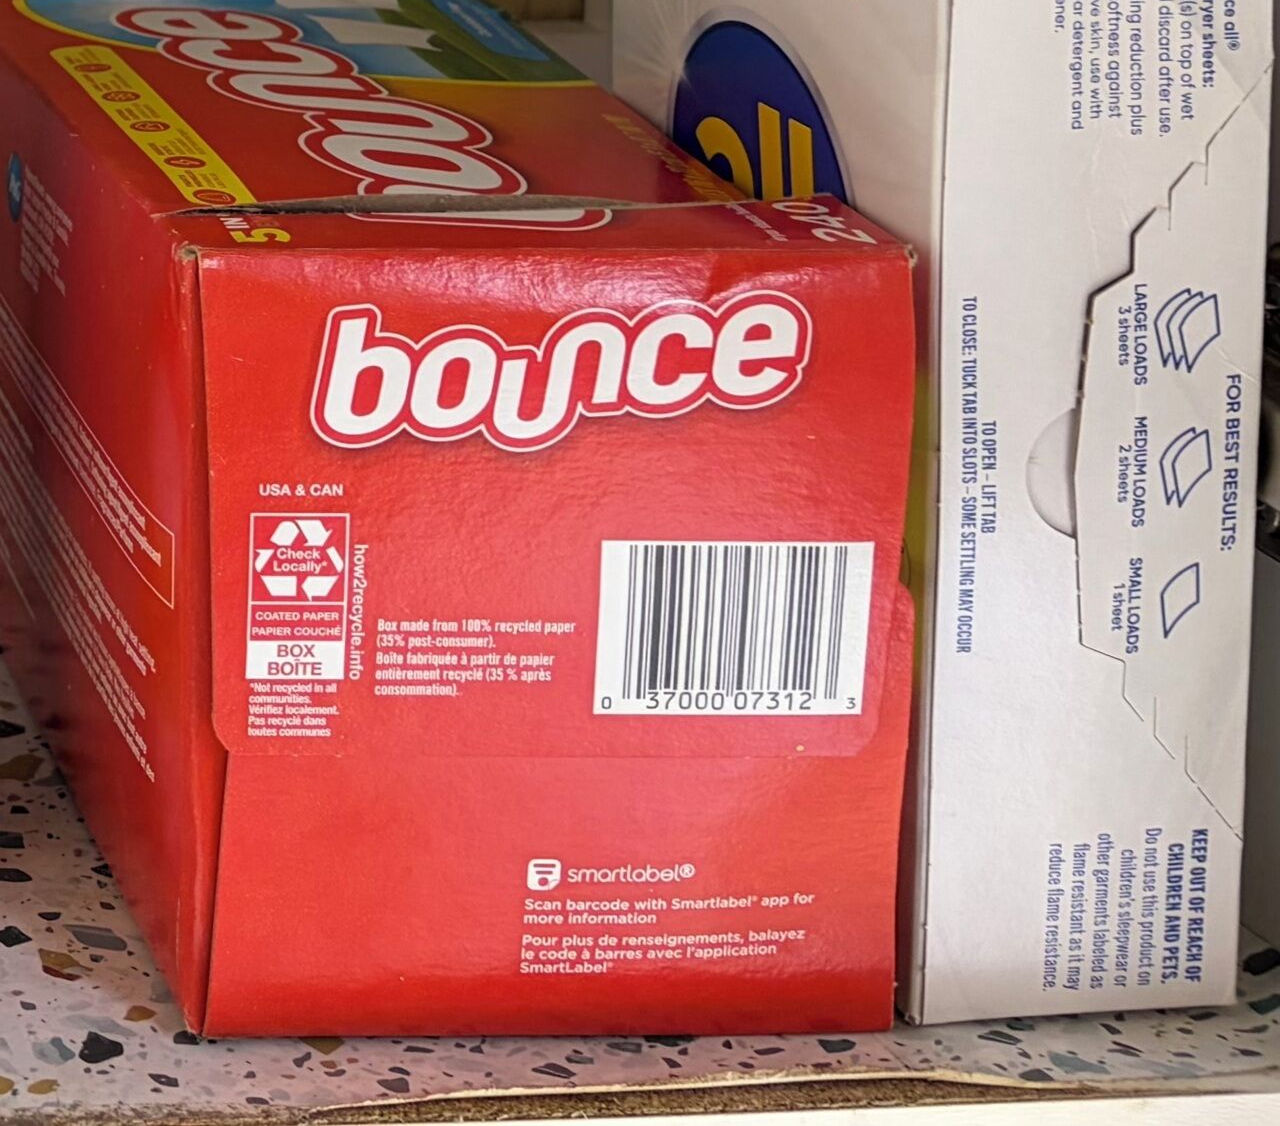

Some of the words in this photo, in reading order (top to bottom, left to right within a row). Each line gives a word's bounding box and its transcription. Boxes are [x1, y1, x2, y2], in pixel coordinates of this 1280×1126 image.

[1181, 21, 1193, 39] on
[1177, 44, 1194, 69] top
[1202, 33, 1216, 88] sheets:
[1181, 73, 1195, 88] of
[1181, 93, 1194, 120] wet
[1119, 306, 1131, 316] 3
[1134, 283, 1147, 332] LARGE
[1118, 318, 1131, 365] sheets
[318, 298, 806, 447] bounce
[1134, 335, 1147, 385] LOADS
[1227, 374, 1241, 412] FOR
[982, 421, 996, 435] TO
[1224, 418, 1240, 462] BEST
[982, 438, 996, 470] OPEN
[1119, 445, 1131, 454] 2
[1133, 416, 1147, 476] MEDIUM
[258, 483, 291, 496] USA
[294, 483, 306, 496] &
[311, 483, 344, 496] CAN
[1118, 456, 1131, 503] sheets
[982, 484, 995, 509] LIFT
[1132, 479, 1146, 527] LOADS
[982, 512, 995, 533] TAB
[1221, 468, 1238, 552] RESULTS:
[276, 547, 320, 560] Check
[1128, 558, 1142, 604] SMALL
[255, 611, 301, 621] COATED
[303, 611, 340, 621] PAPER
[348, 544, 369, 681] how2recycle.info
[1111, 592, 1124, 631] sheet
[251, 627, 291, 637] PAPIER
[293, 625, 342, 637] COUCHÉ
[377, 618, 397, 632] Box
[400, 619, 429, 632] made
[432, 619, 458, 632] from
[461, 618, 492, 632] 100%
[494, 619, 541, 635] recycled
[544, 621, 576, 636] paper
[1126, 606, 1140, 654] LOADS
[276, 644, 316, 658] BOX
[376, 633, 405, 649] (35%
[267, 658, 323, 676] BOÎTE
[600, 696, 612, 710] 0
[646, 690, 725, 711] 37000
[733, 691, 813, 711] 07312
[845, 696, 857, 710] 3
[1191, 829, 1208, 862] KEEP
[1165, 843, 1184, 910] CHILDREN
[1190, 867, 1206, 892] OUT
[524, 898, 562, 911] Scan
[565, 898, 630, 911] barcode
[634, 897, 667, 911] with
[761, 893, 790, 908] app
[793, 892, 816, 905] for
[1189, 897, 1205, 913] OF
[523, 913, 565, 925] more
[568, 911, 657, 925] information
[1164, 916, 1180, 943] AND
[1187, 918, 1204, 961] REACH
[1161, 947, 1179, 984] PETS.
[1185, 966, 1201, 983] OF
